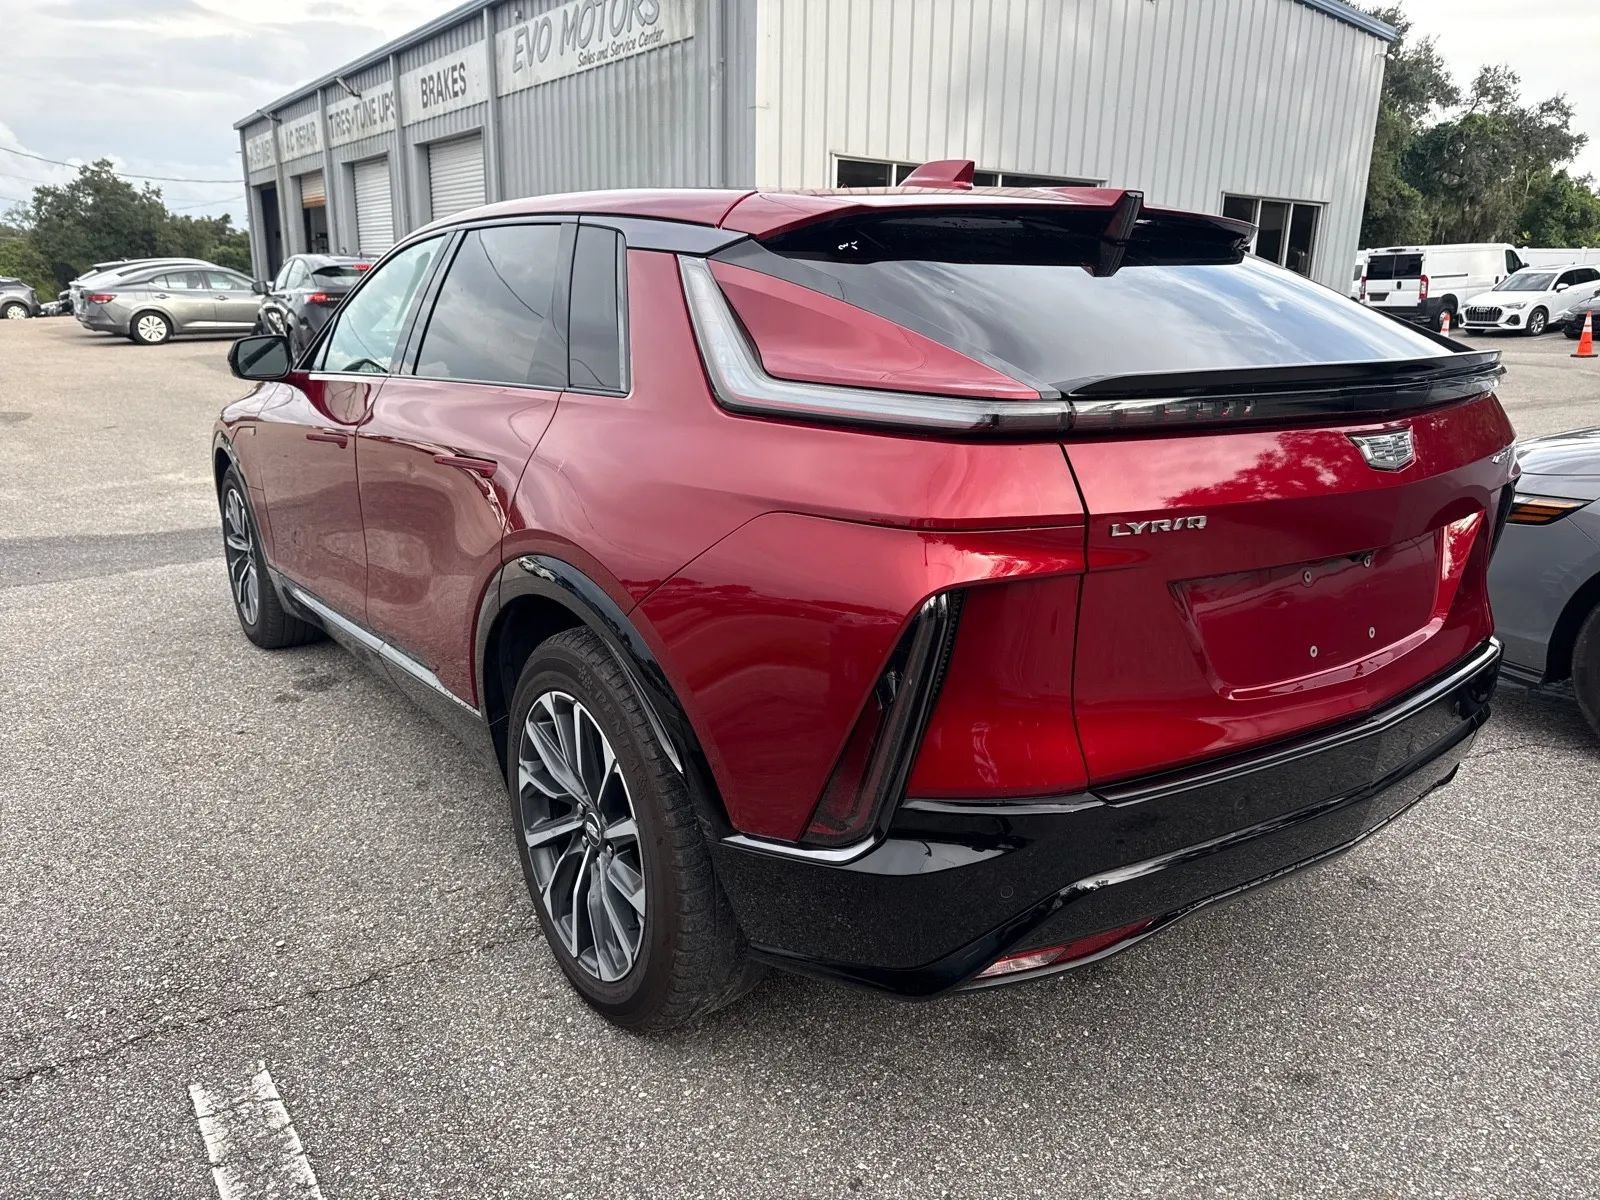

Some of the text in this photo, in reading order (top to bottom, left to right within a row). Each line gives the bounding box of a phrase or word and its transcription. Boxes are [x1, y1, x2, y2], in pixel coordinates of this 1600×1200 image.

[512, 0, 660, 74] EVO MOTORS
[577, 26, 664, 67] Sales and Service Center
[420, 61, 467, 109] BRAKES
[1111, 515, 1208, 537] LYRIQ
